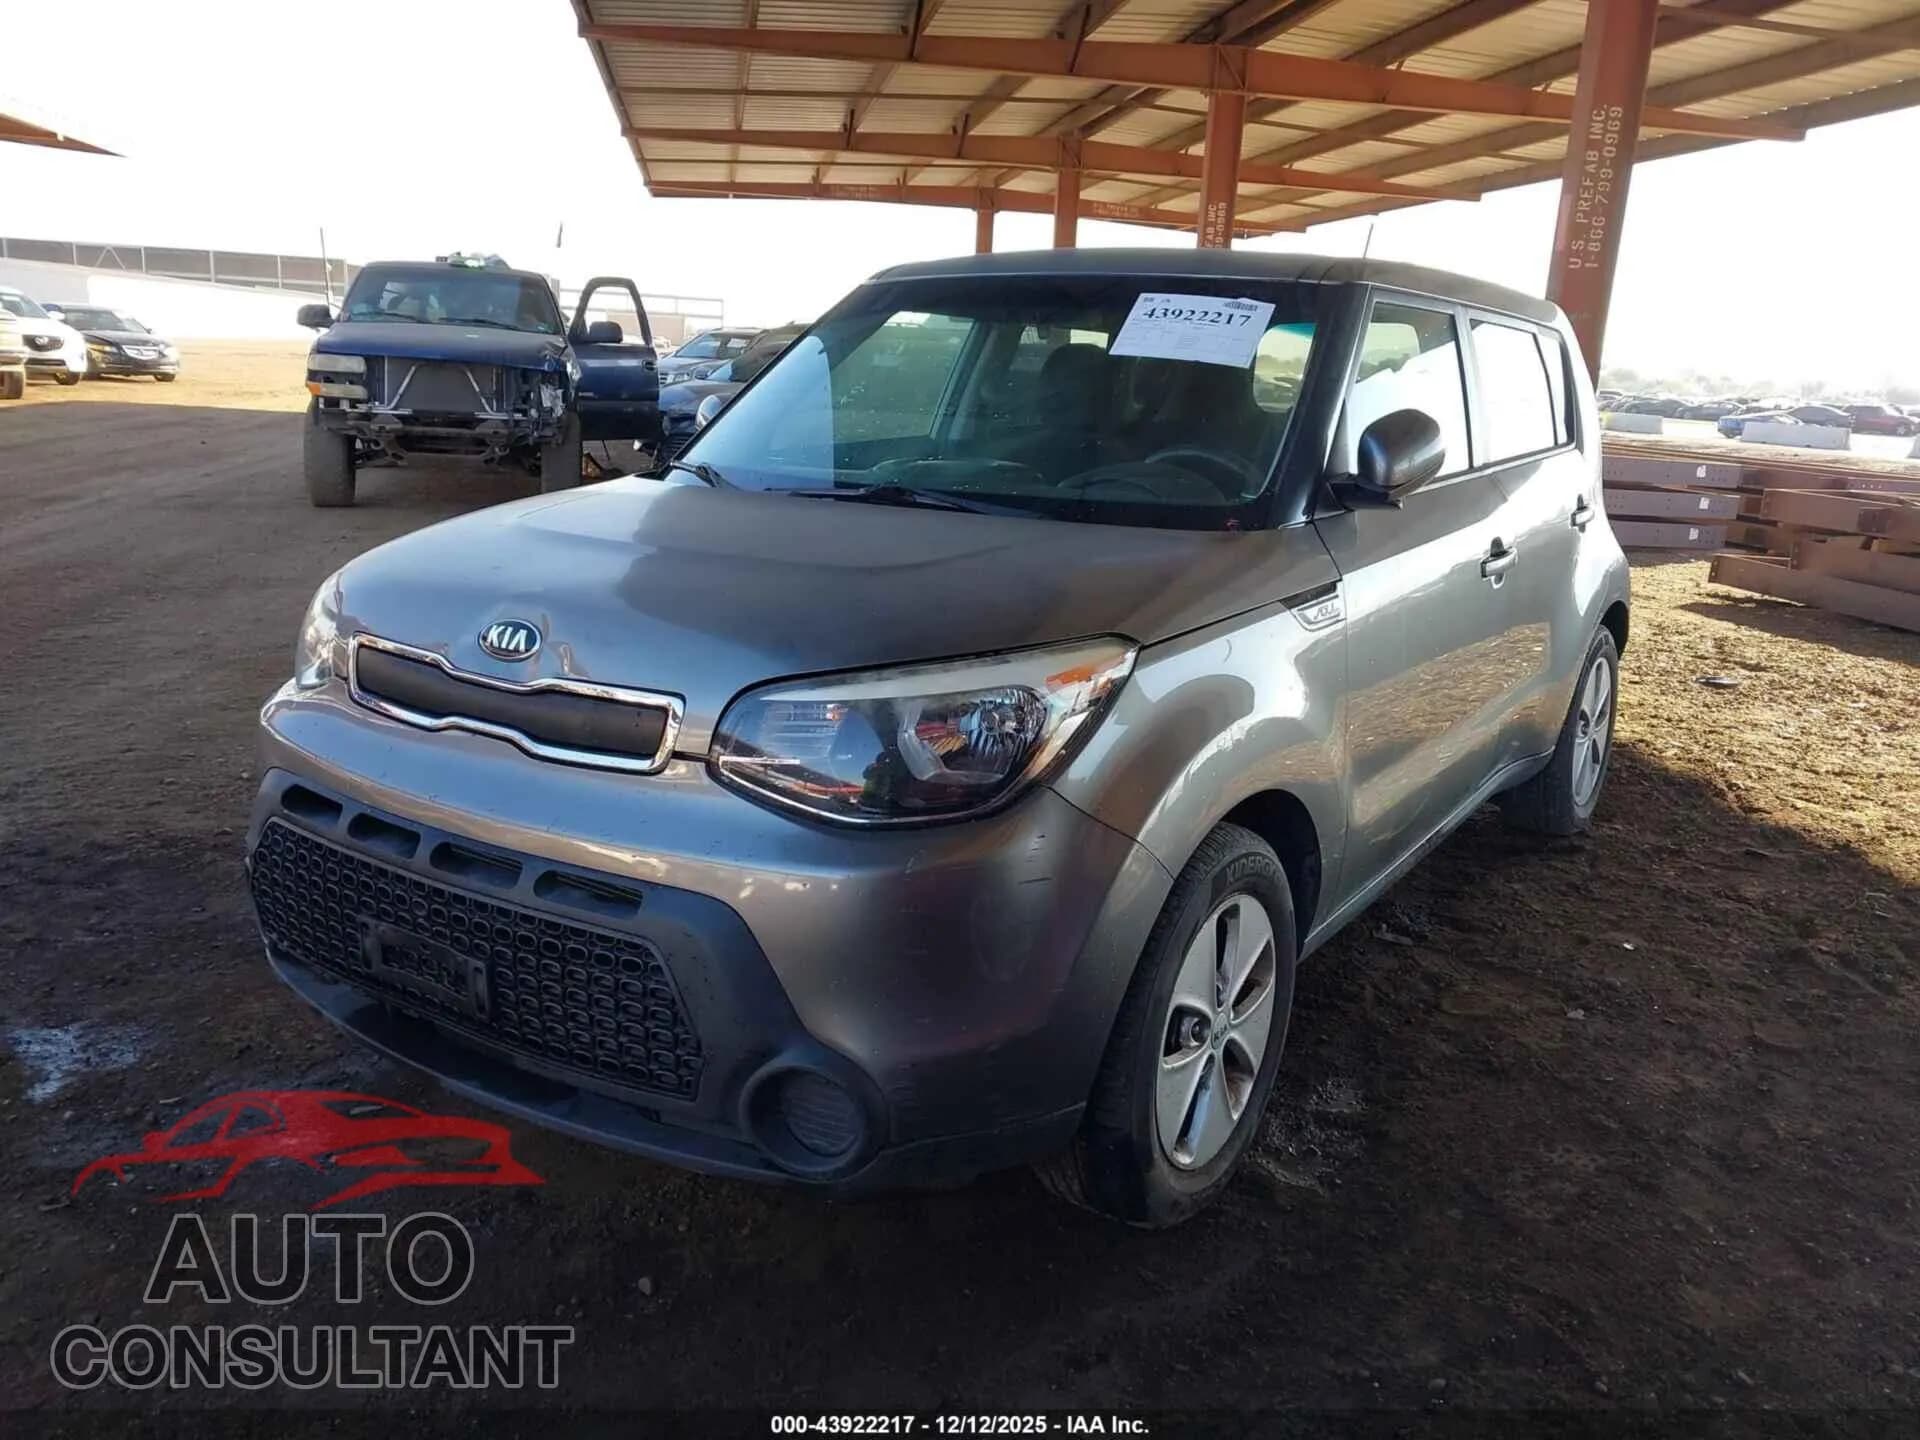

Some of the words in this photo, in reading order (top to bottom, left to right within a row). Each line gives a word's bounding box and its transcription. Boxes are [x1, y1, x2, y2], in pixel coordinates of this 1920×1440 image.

[1575, 150, 1600, 223] PREFAB
[1589, 104, 1607, 140] INC.
[1143, 307, 1251, 326] 43922217
[485, 625, 528, 652] KIA
